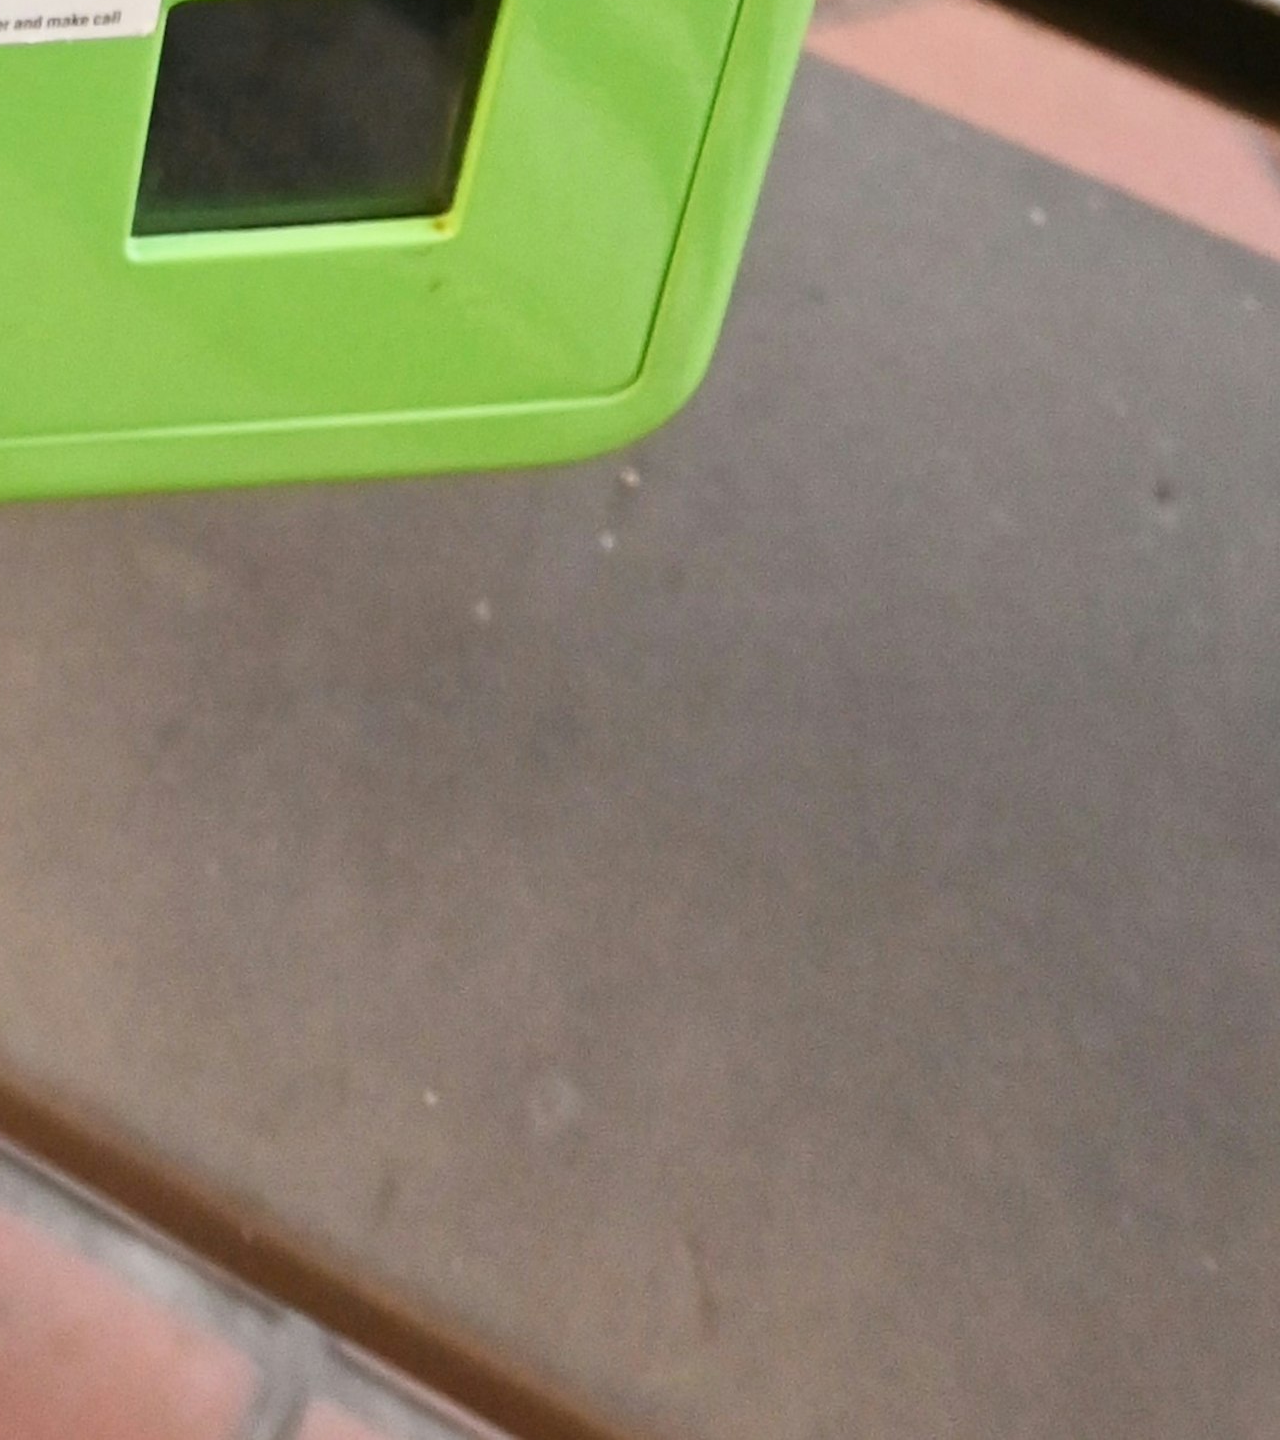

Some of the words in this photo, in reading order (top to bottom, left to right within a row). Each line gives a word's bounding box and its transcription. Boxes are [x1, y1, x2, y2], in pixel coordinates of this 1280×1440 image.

[14, 16, 43, 31] and
[46, 13, 90, 29] make
[93, 11, 122, 26] call
